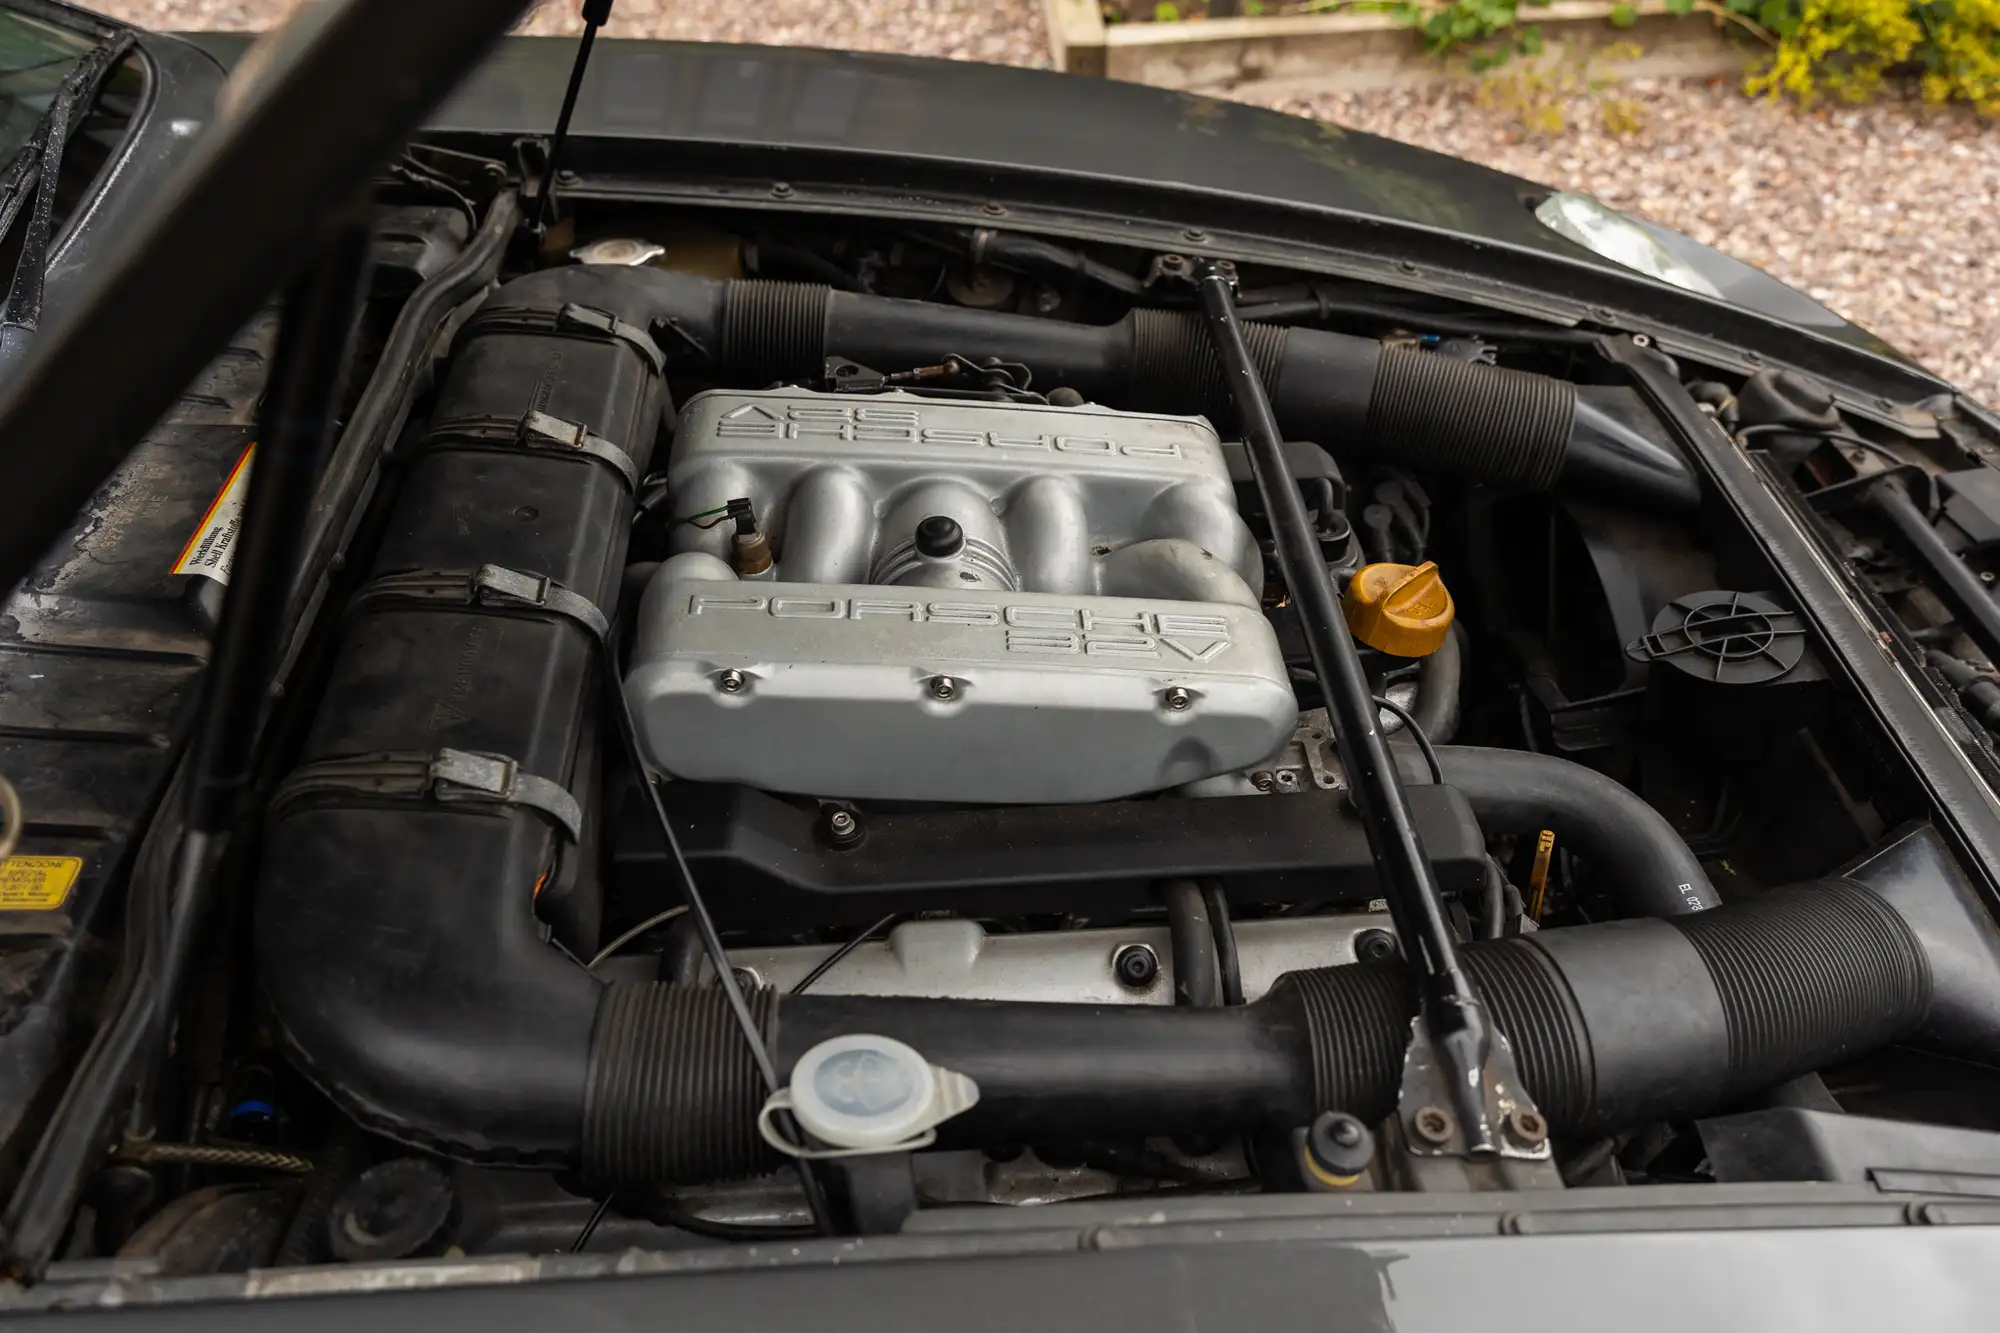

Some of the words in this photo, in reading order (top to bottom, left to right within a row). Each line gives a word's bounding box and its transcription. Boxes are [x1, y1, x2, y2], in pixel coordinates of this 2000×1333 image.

[716, 421, 1183, 460] PORSCHE
[204, 549, 223, 569] Shell
[688, 594, 1228, 636] PORSCHE
[1005, 629, 1230, 662] 32V
